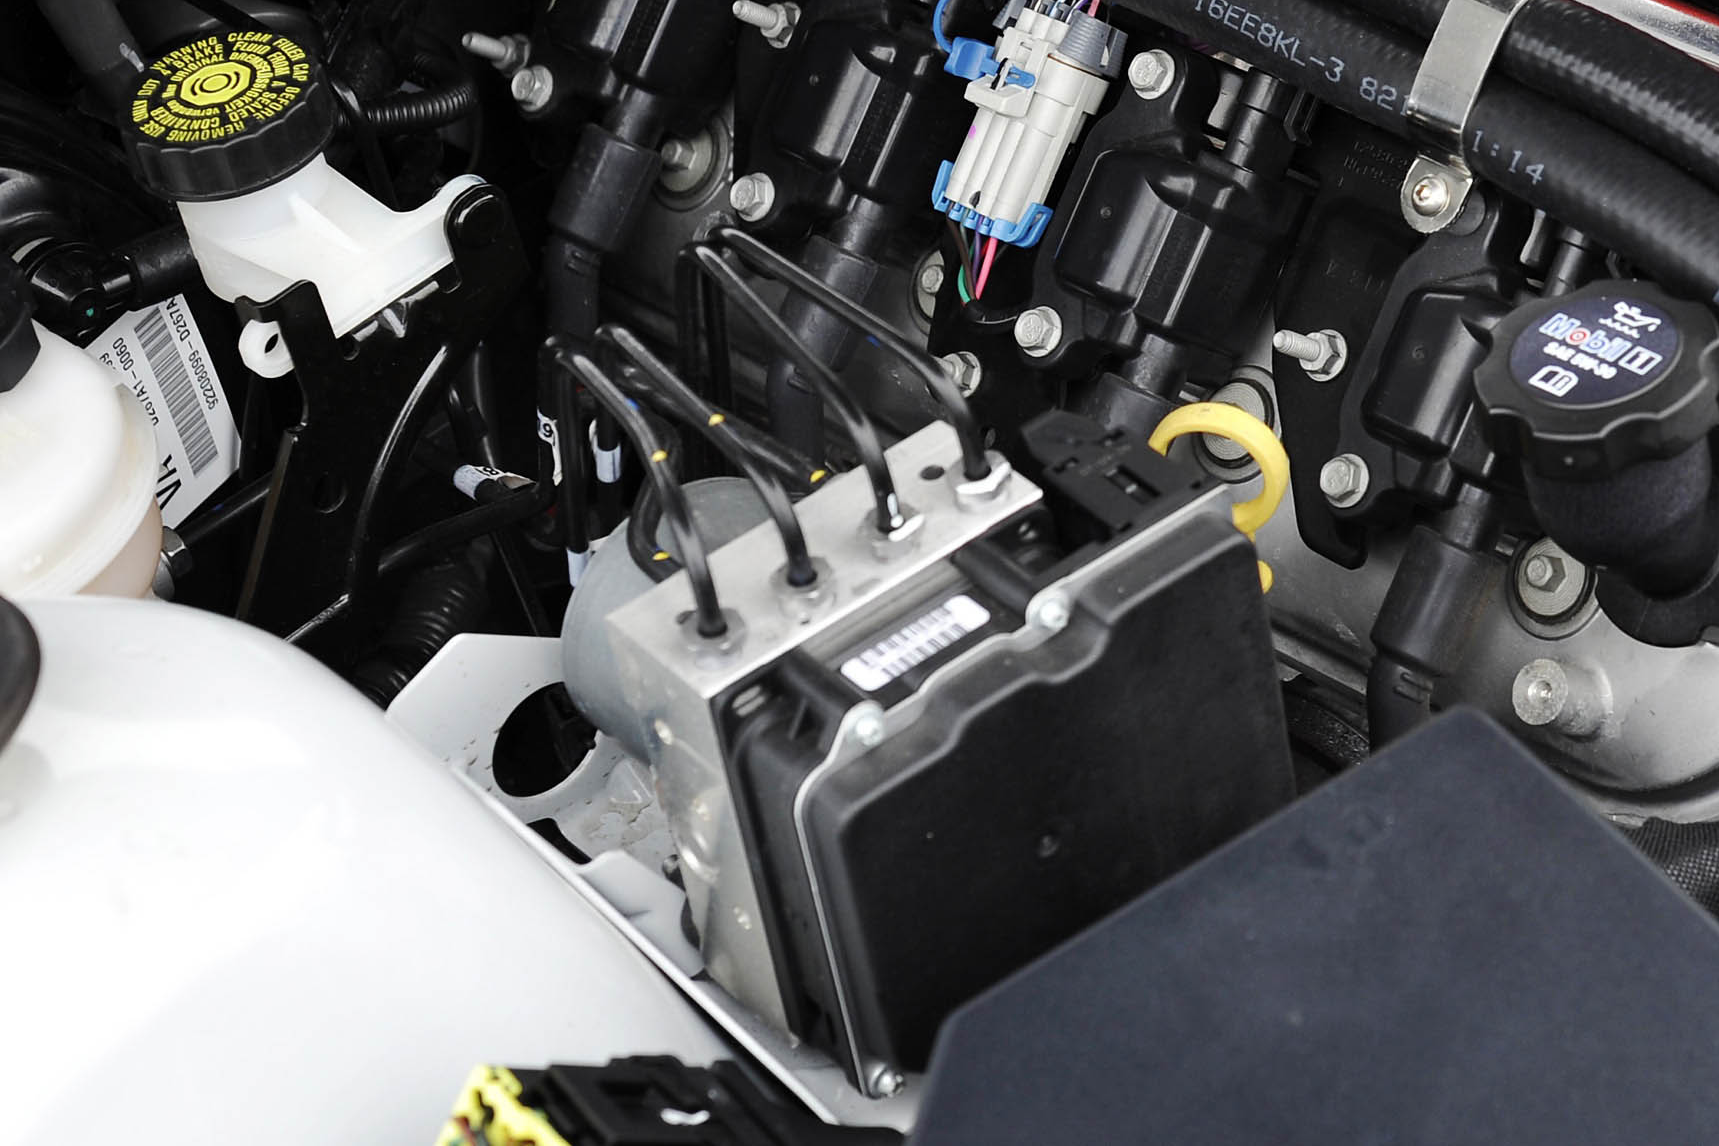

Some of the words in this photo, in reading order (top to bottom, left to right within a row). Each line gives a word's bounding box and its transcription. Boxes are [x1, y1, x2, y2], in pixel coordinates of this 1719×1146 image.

[227, 32, 272, 43] CLEAN
[232, 41, 272, 55] FLUID
[272, 38, 306, 61] FILLER
[152, 36, 218, 71] WARNING
[171, 43, 224, 70] BRAKE
[267, 51, 291, 77] FROM
[171, 54, 225, 82] ORIGINAL
[292, 63, 310, 81] CAP
[137, 78, 161, 96] DOT
[228, 92, 277, 122] SEALED
[253, 86, 301, 120] BEFORE
[139, 120, 166, 138] USE
[150, 106, 220, 130] CONTAINER
[166, 120, 246, 142] REMOVING
[1539, 313, 1633, 362] Mobil
